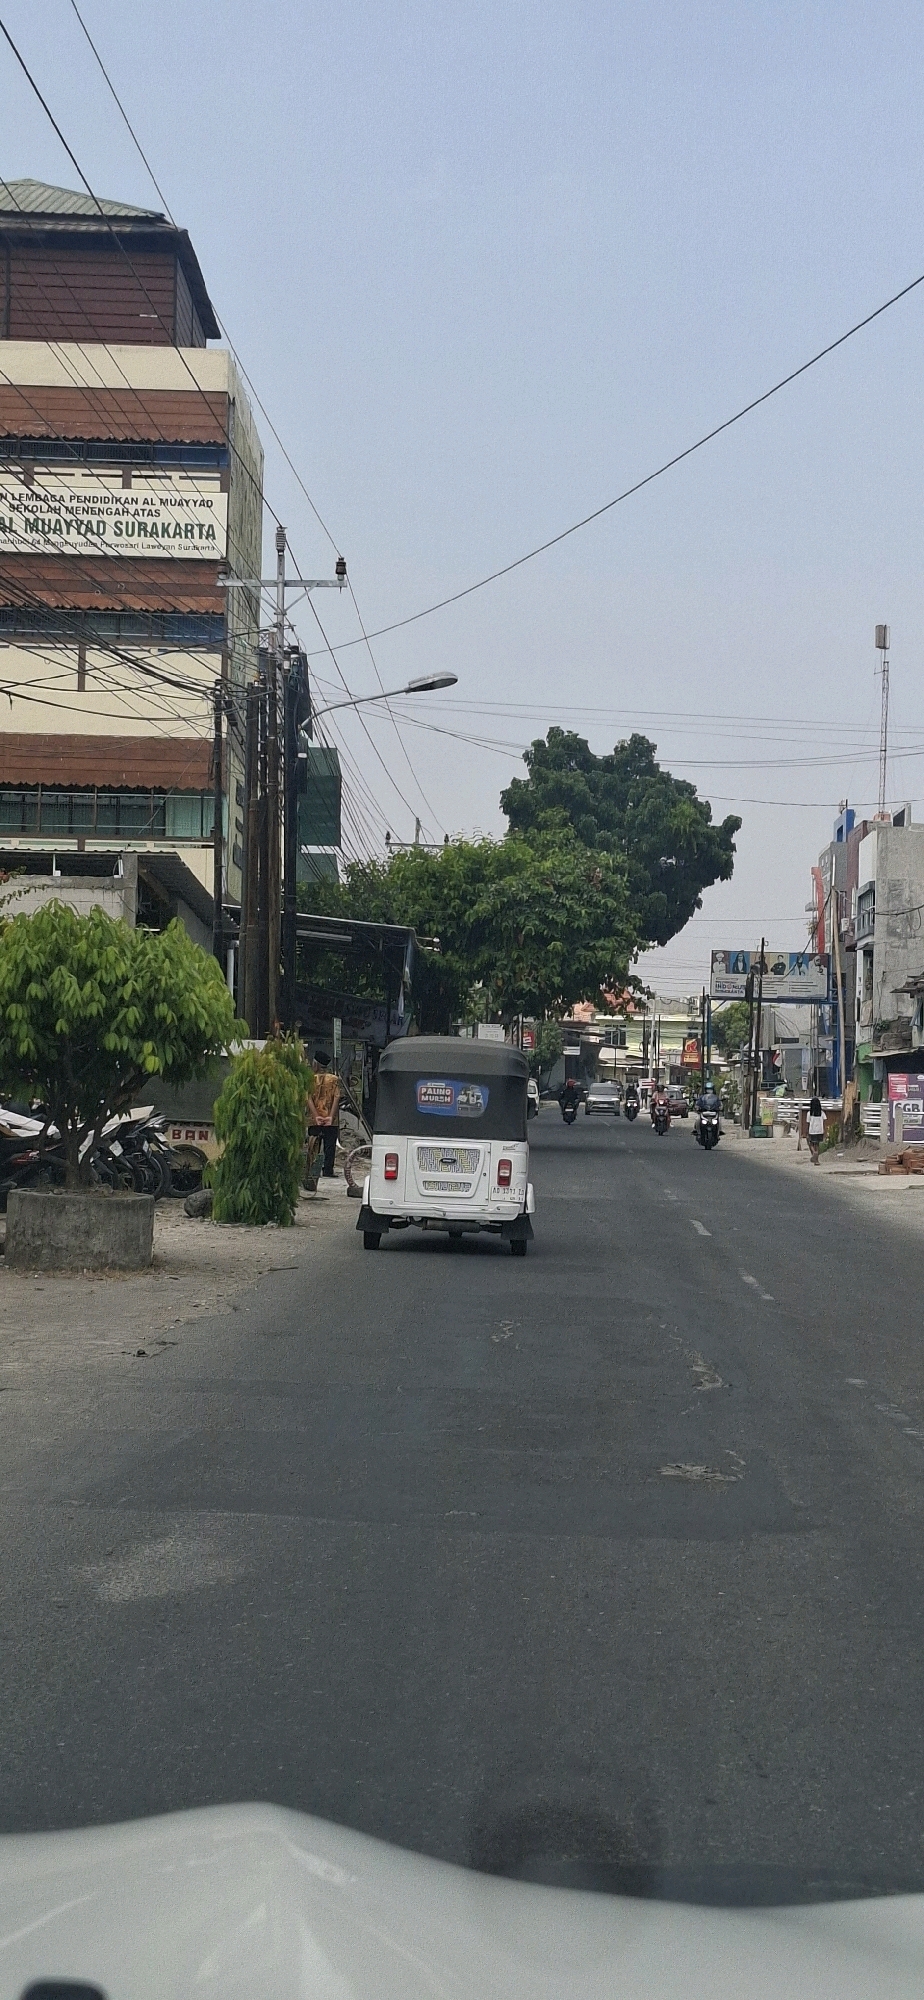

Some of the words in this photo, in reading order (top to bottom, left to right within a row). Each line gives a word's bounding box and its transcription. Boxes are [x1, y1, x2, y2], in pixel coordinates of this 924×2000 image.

[70, 495, 139, 506] PENDIDIKAN
[143, 497, 156, 506] AL
[160, 498, 214, 508] MUAYYAD
[9, 503, 61, 514] SEKOLAH
[65, 506, 130, 517] MENENGAH
[133, 508, 161, 518] ATAS
[25, 517, 107, 537] MUAYYAD
[113, 521, 217, 541] SURAKARTA
[172, 1129, 209, 1140] BAN
